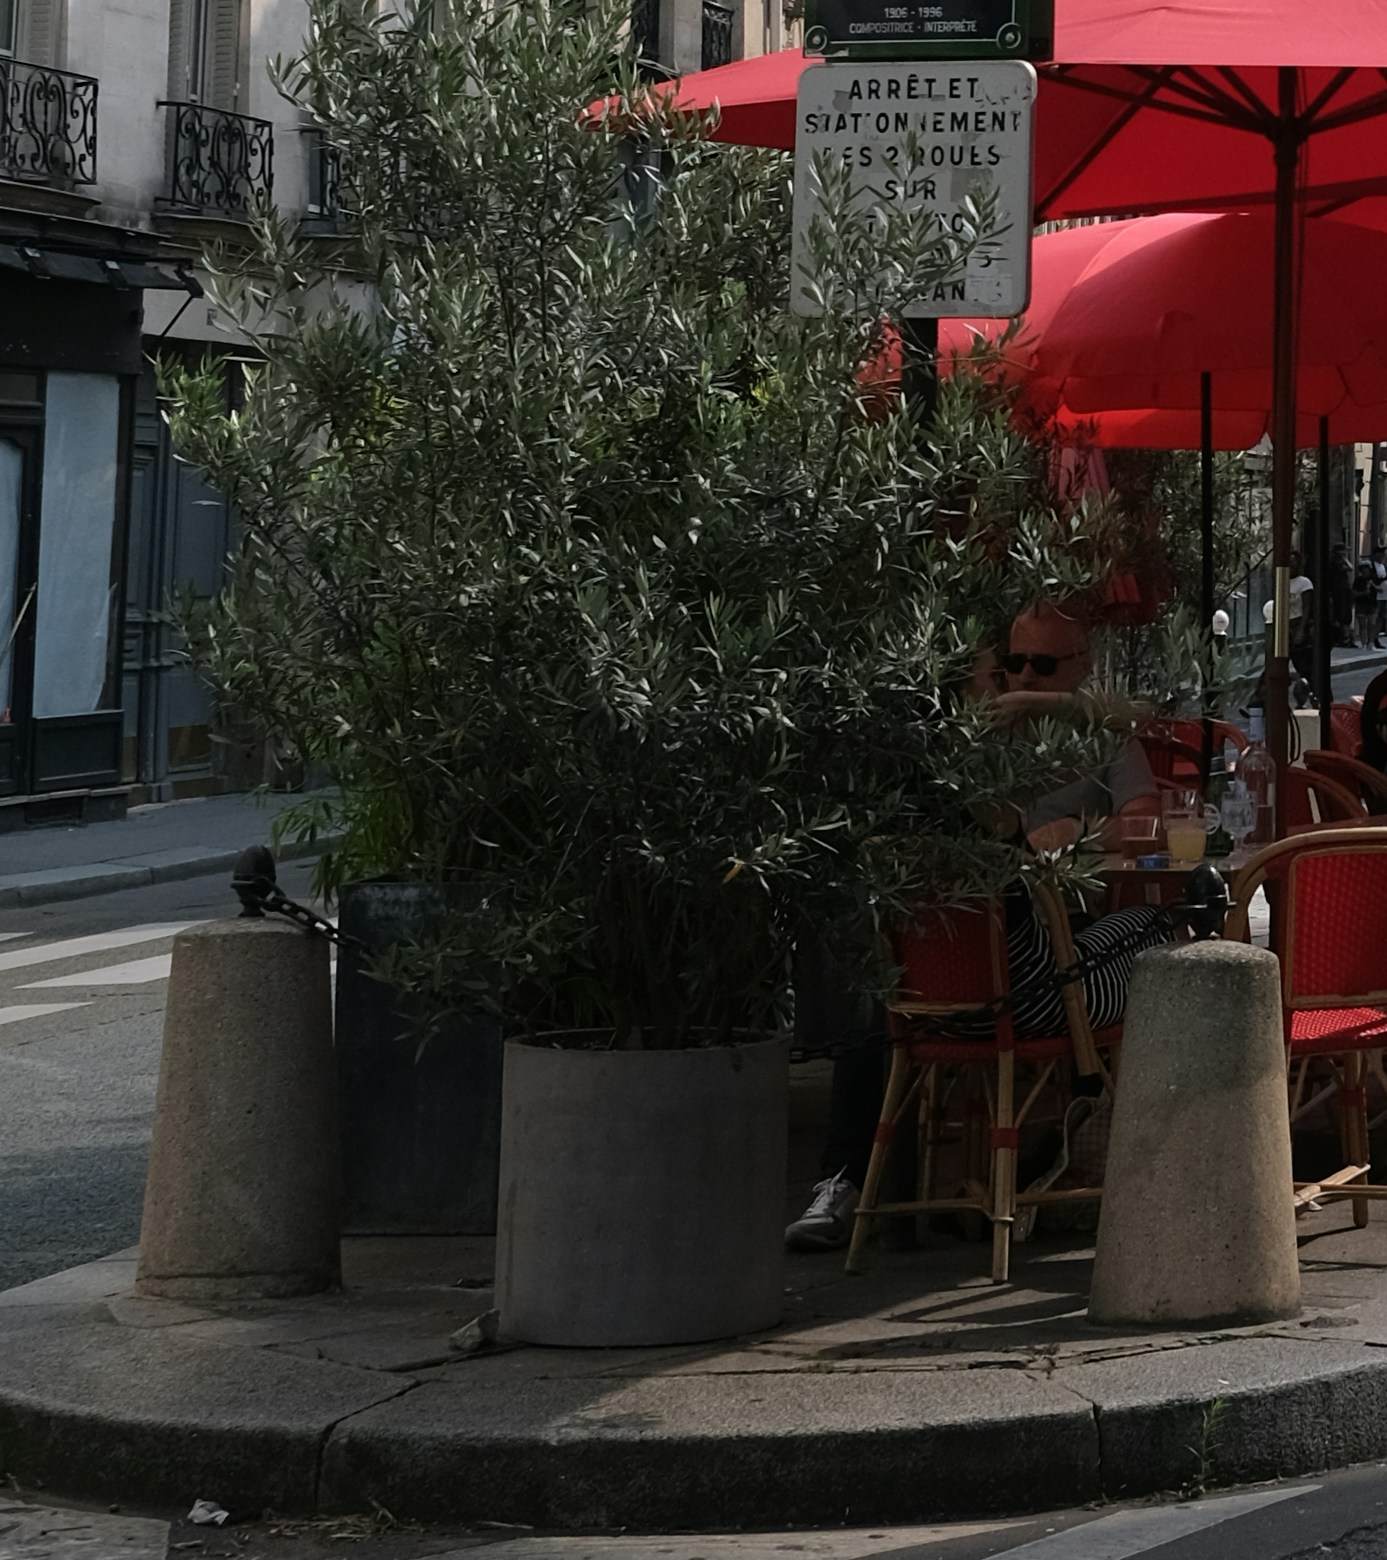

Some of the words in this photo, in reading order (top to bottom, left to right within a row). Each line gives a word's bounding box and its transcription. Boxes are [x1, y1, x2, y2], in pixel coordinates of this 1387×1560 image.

[919, 6, 943, 18] 1996
[849, 22, 914, 34] COMPOSITRICE
[850, 74, 936, 100] ARRÊT
[949, 77, 979, 99] ET
[885, 146, 899, 167] 2
